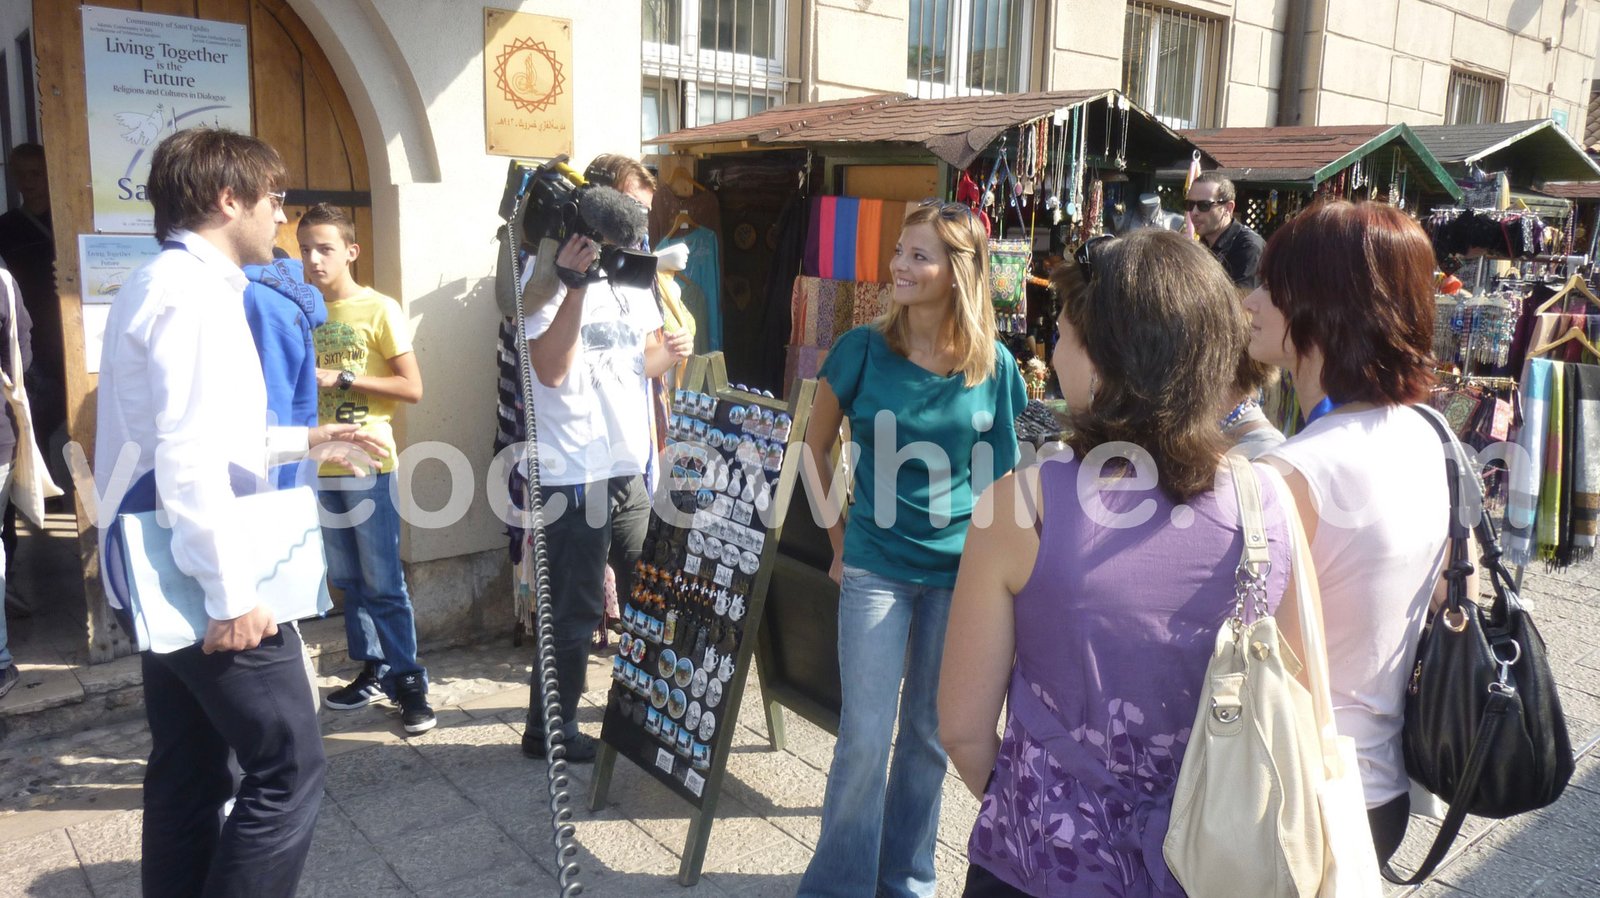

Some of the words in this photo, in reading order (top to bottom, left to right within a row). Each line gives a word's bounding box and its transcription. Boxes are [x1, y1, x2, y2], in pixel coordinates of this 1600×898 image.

[126, 17, 163, 29] Community
[106, 37, 155, 60] Living
[158, 42, 228, 64] Together
[157, 61, 165, 70] is
[167, 62, 182, 72] the
[143, 69, 195, 88] Future
[113, 85, 145, 95] Religions
[146, 87, 159, 96] and
[160, 89, 188, 99] Cultures
[197, 92, 226, 102] Dialogue
